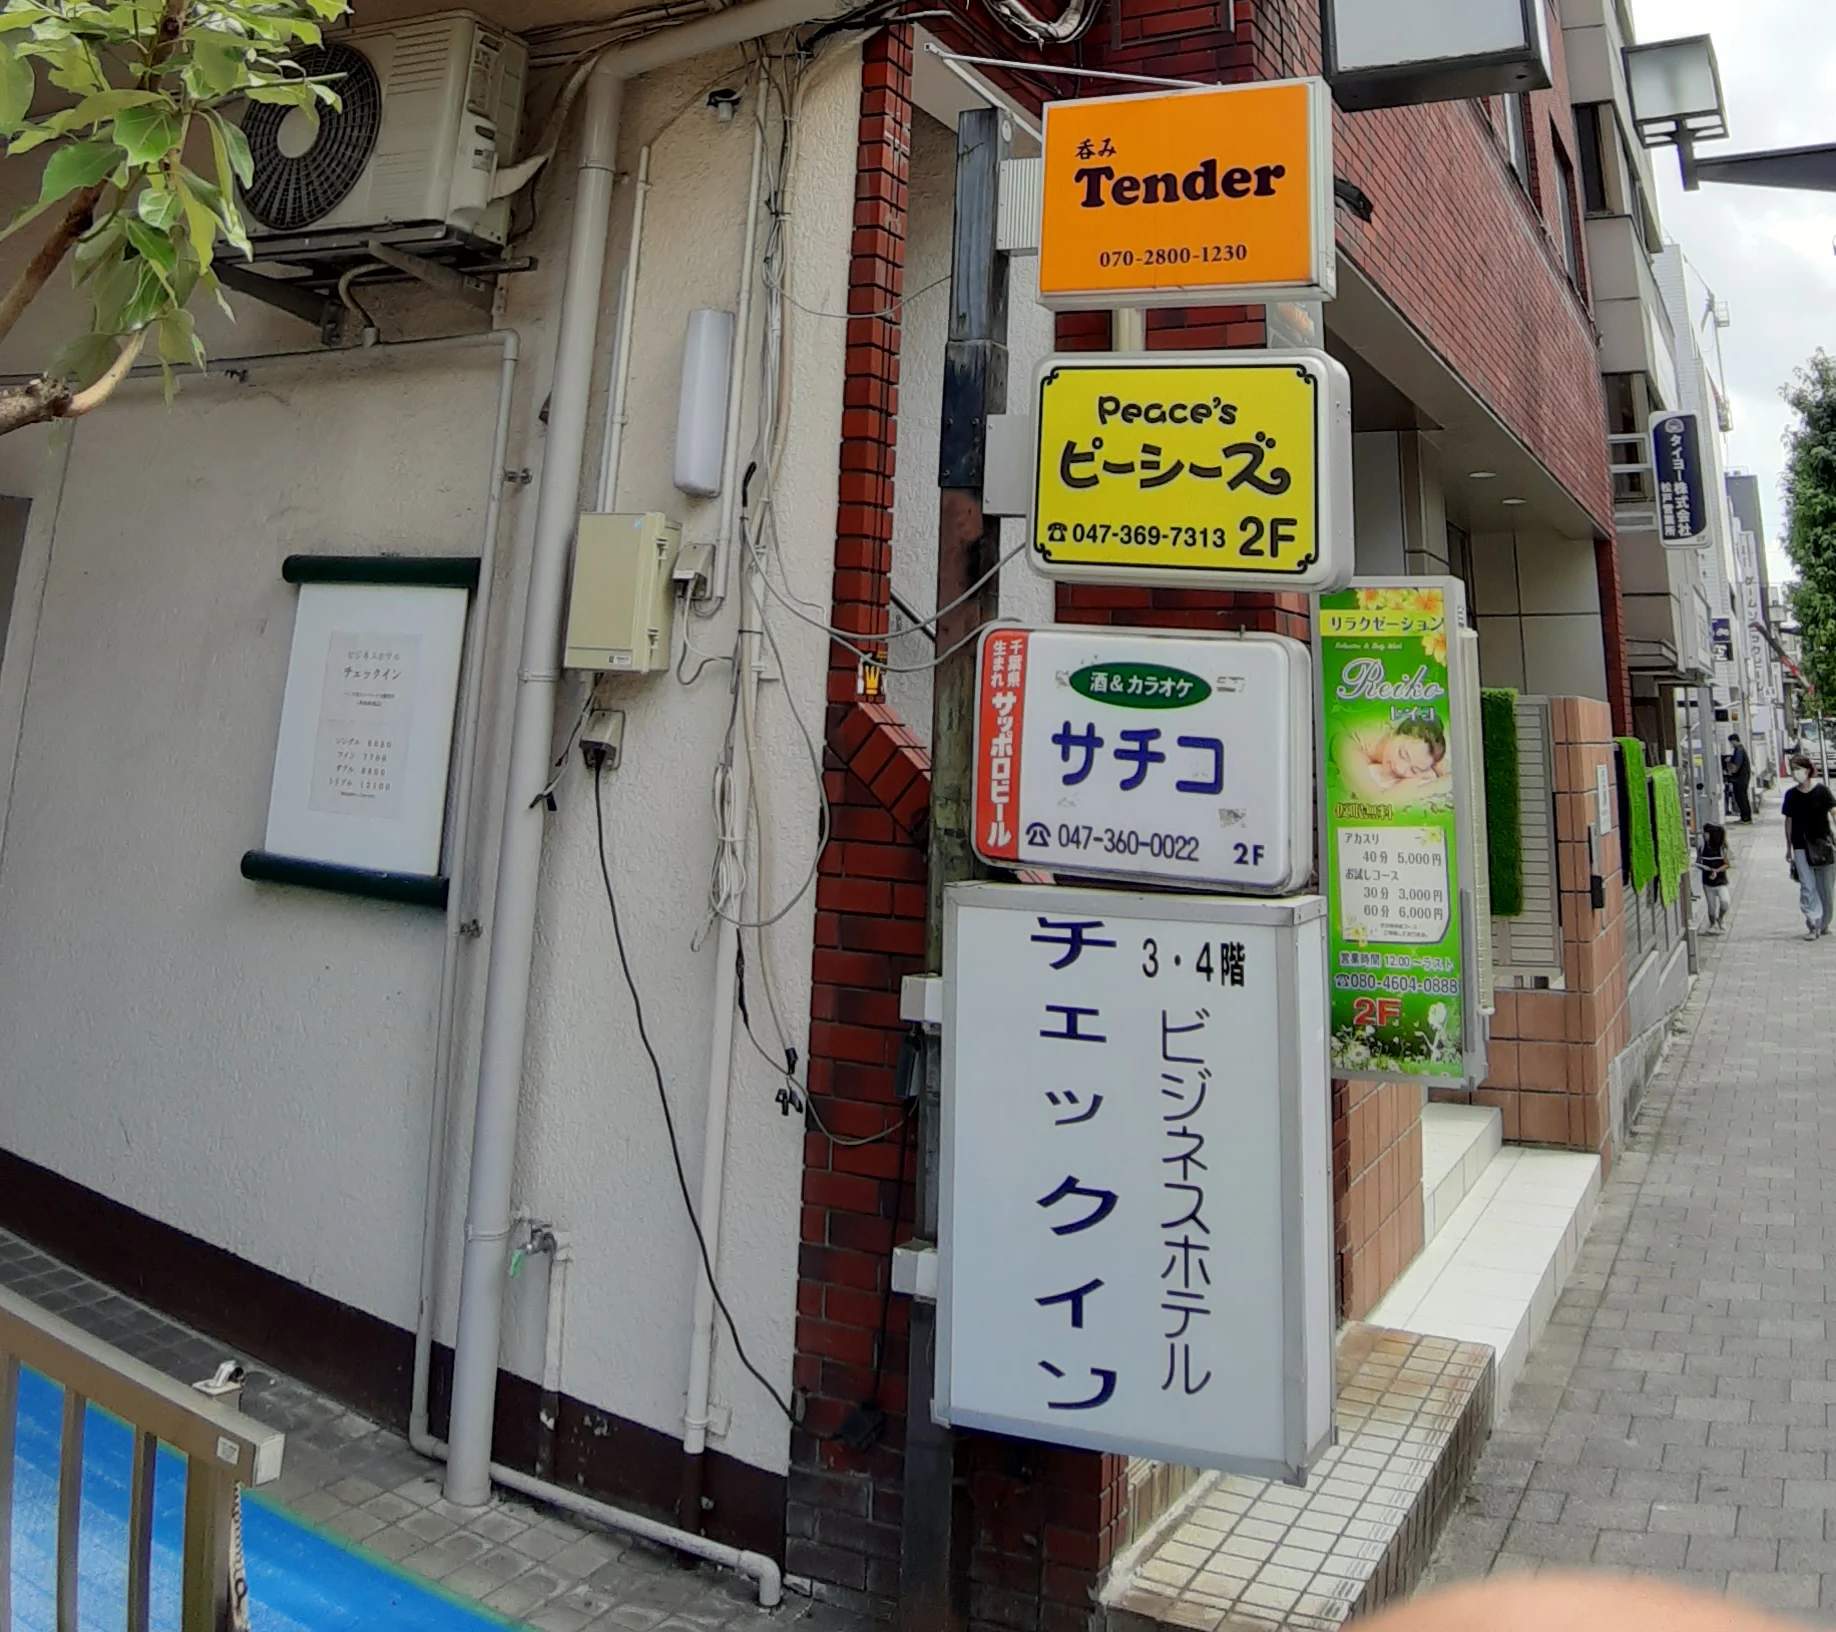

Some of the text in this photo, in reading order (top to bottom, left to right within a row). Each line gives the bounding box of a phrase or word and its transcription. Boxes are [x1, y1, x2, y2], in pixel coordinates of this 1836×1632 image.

[1075, 137, 1117, 160] 呑み
[1074, 158, 1287, 209] Tender
[1099, 243, 1248, 268] 070-2800-1230
[1098, 396, 1239, 426] Peace's
[1059, 431, 1292, 496] ピーシーズ
[1072, 516, 1299, 559] 047-369-7313 2F
[1330, 616, 1444, 632] リラクゼーション
[344, 666, 402, 680] チェックイン
[990, 640, 1007, 688] 生まれ
[1007, 639, 1023, 688] 千葉県
[1336, 657, 1444, 700] Reiko
[1390, 705, 1435, 721] レイコ
[987, 691, 1017, 848] サッポロビール
[1051, 720, 1224, 795] サチコ
[1058, 823, 1265, 866] 047-360-0022 2F
[1344, 832, 1379, 844] アカスリ
[1350, 974, 1458, 994] 080-4604-0888
[1353, 997, 1402, 1026] 2F
[1160, 1008, 1212, 1395] ビジネスホテル
